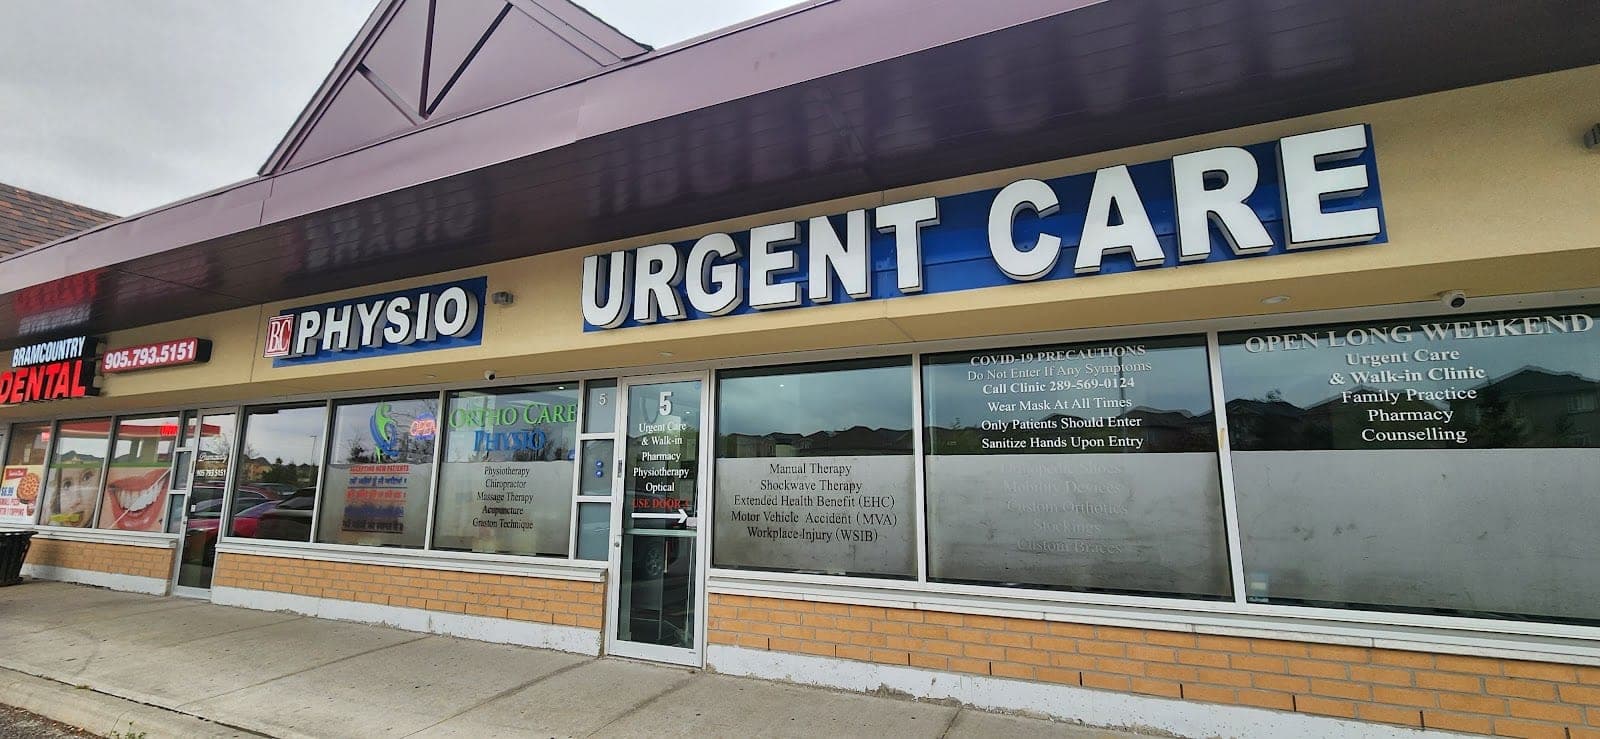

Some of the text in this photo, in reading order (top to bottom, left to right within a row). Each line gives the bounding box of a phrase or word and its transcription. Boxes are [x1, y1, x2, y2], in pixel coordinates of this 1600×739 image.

[581, 123, 1382, 328] URGENT CARE
[296, 286, 474, 355] PHYSIO
[1244, 313, 1594, 354] OPEN LONG WEEKEND
[12, 335, 86, 368] BRAMCOUNTRY
[104, 340, 195, 370] 905.793.5151
[970, 344, 1146, 367] COVID-19 PRECAUTIONS
[1346, 348, 1460, 367] Urgent Care
[967, 360, 1152, 382] Do Not Enter If Any Symptoms
[1329, 366, 1485, 386] & Walk-in Clinic
[0, 360, 86, 405] DENTAL
[982, 376, 1135, 396] Call Clinic 289-569-0124
[598, 393, 608, 406] 5
[659, 391, 673, 416] 5
[987, 396, 1132, 413] Wear Mask At All Times
[1342, 387, 1477, 407] Family Practice
[449, 402, 578, 429] ORTHO CARE
[1367, 408, 1454, 424] Pharmacy
[639, 421, 687, 434] Urgent Care
[981, 416, 1142, 433] Only Patients Should Enter
[473, 429, 546, 452] PHYSIO
[641, 435, 683, 446] & Walk-in
[981, 436, 1144, 451] Sanitize Hands Upon Entry
[1361, 427, 1468, 444] Counselling
[641, 451, 682, 463] Pharmacy
[484, 466, 531, 478] Physiotherapy
[633, 467, 690, 479] Physiotherapy
[769, 462, 852, 477] Manual Therapy
[485, 478, 527, 490] Chiropractor
[645, 481, 675, 494] Optical
[760, 479, 863, 493] Shockwave Therapy
[477, 491, 534, 504] Massage Therapy
[632, 498, 649, 509] USE
[652, 498, 681, 510] DOOR
[733, 494, 895, 511] Extended Health Benefit (EHC)
[482, 505, 524, 516] Acupuncture
[1006, 500, 1128, 515] Custom Orthotics
[472, 517, 534, 532] Graston Technique
[730, 510, 761, 523] Motor
[763, 510, 799, 523] Vehicle
[805, 511, 852, 525] Accident
[835, 527, 878, 543] (WSIB)
[1016, 538, 1069, 552] Custom
